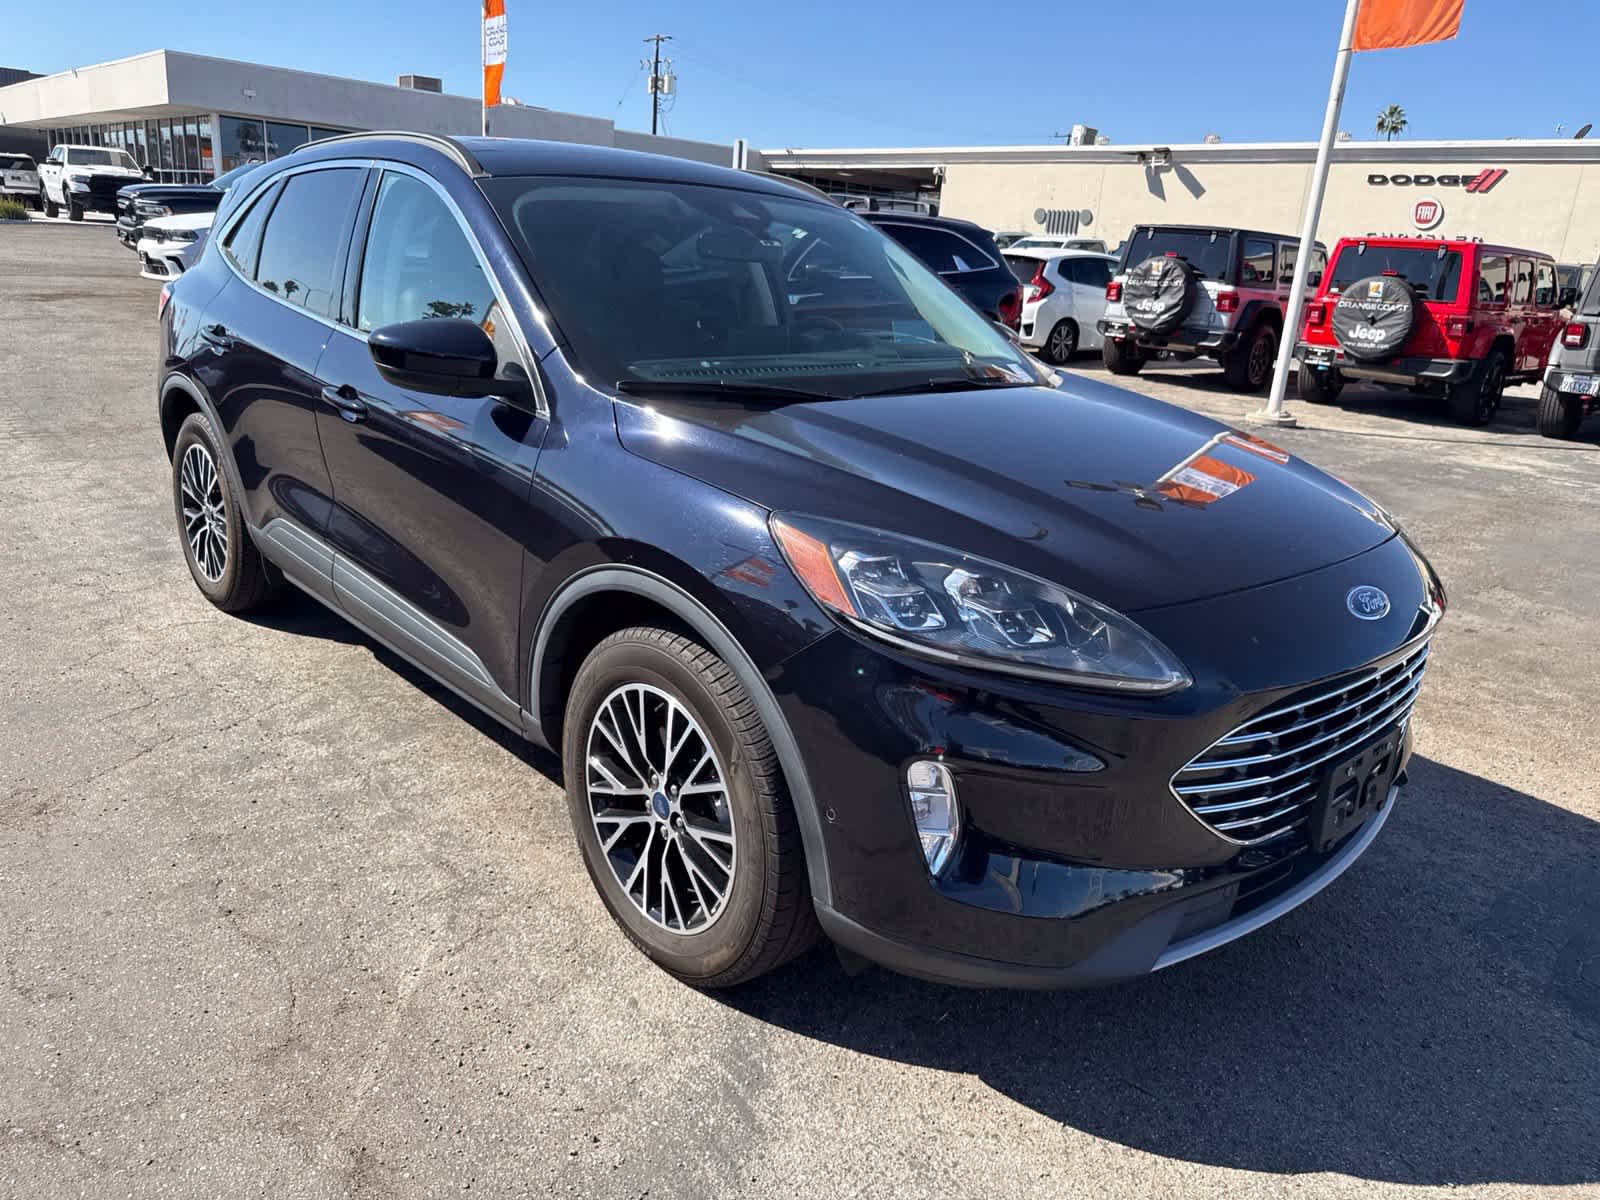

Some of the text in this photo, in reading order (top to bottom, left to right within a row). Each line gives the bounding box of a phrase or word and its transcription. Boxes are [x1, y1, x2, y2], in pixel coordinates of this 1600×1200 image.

[1367, 174, 1480, 187] DODGE
[1416, 205, 1436, 220] FIAT
[1136, 298, 1165, 313] Jeep
[1348, 324, 1386, 342] Jeep
